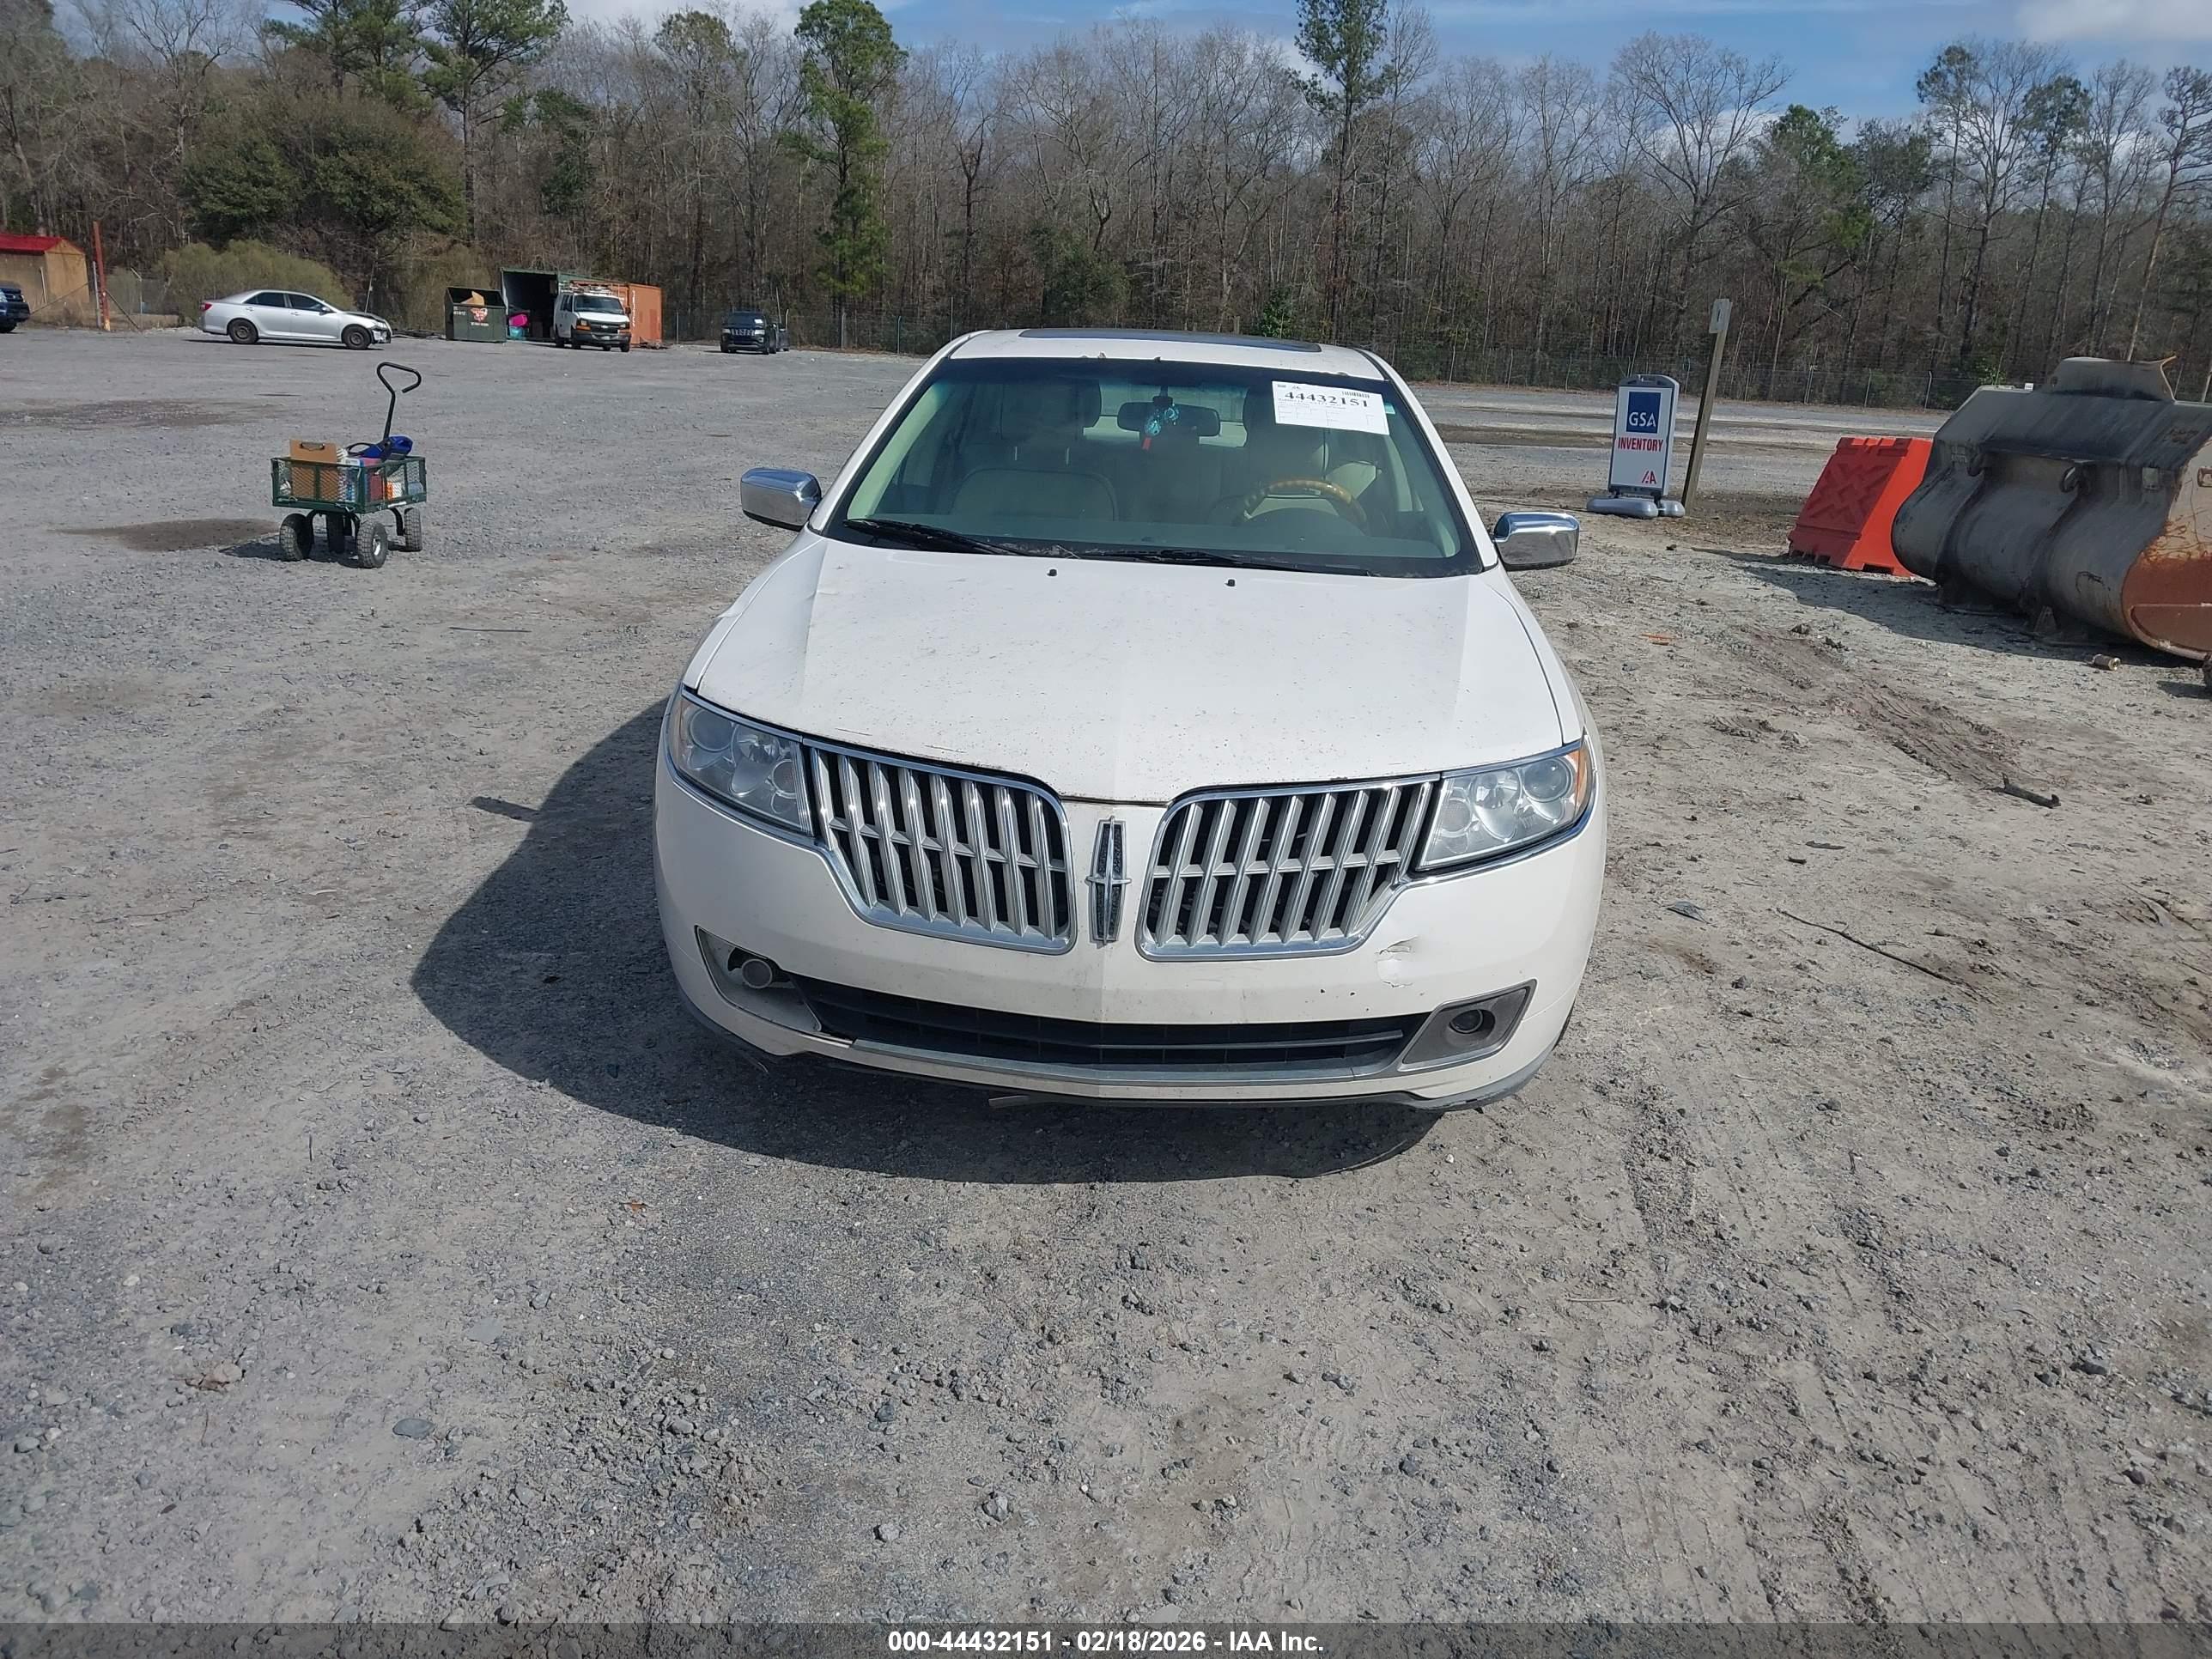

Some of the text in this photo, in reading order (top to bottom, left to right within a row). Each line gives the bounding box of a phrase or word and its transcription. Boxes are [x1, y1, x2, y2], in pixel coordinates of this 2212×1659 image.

[1285, 392, 1368, 407] 44432151
[1629, 412, 1656, 428] GSA
[1618, 437, 1664, 452] INVENTORY
